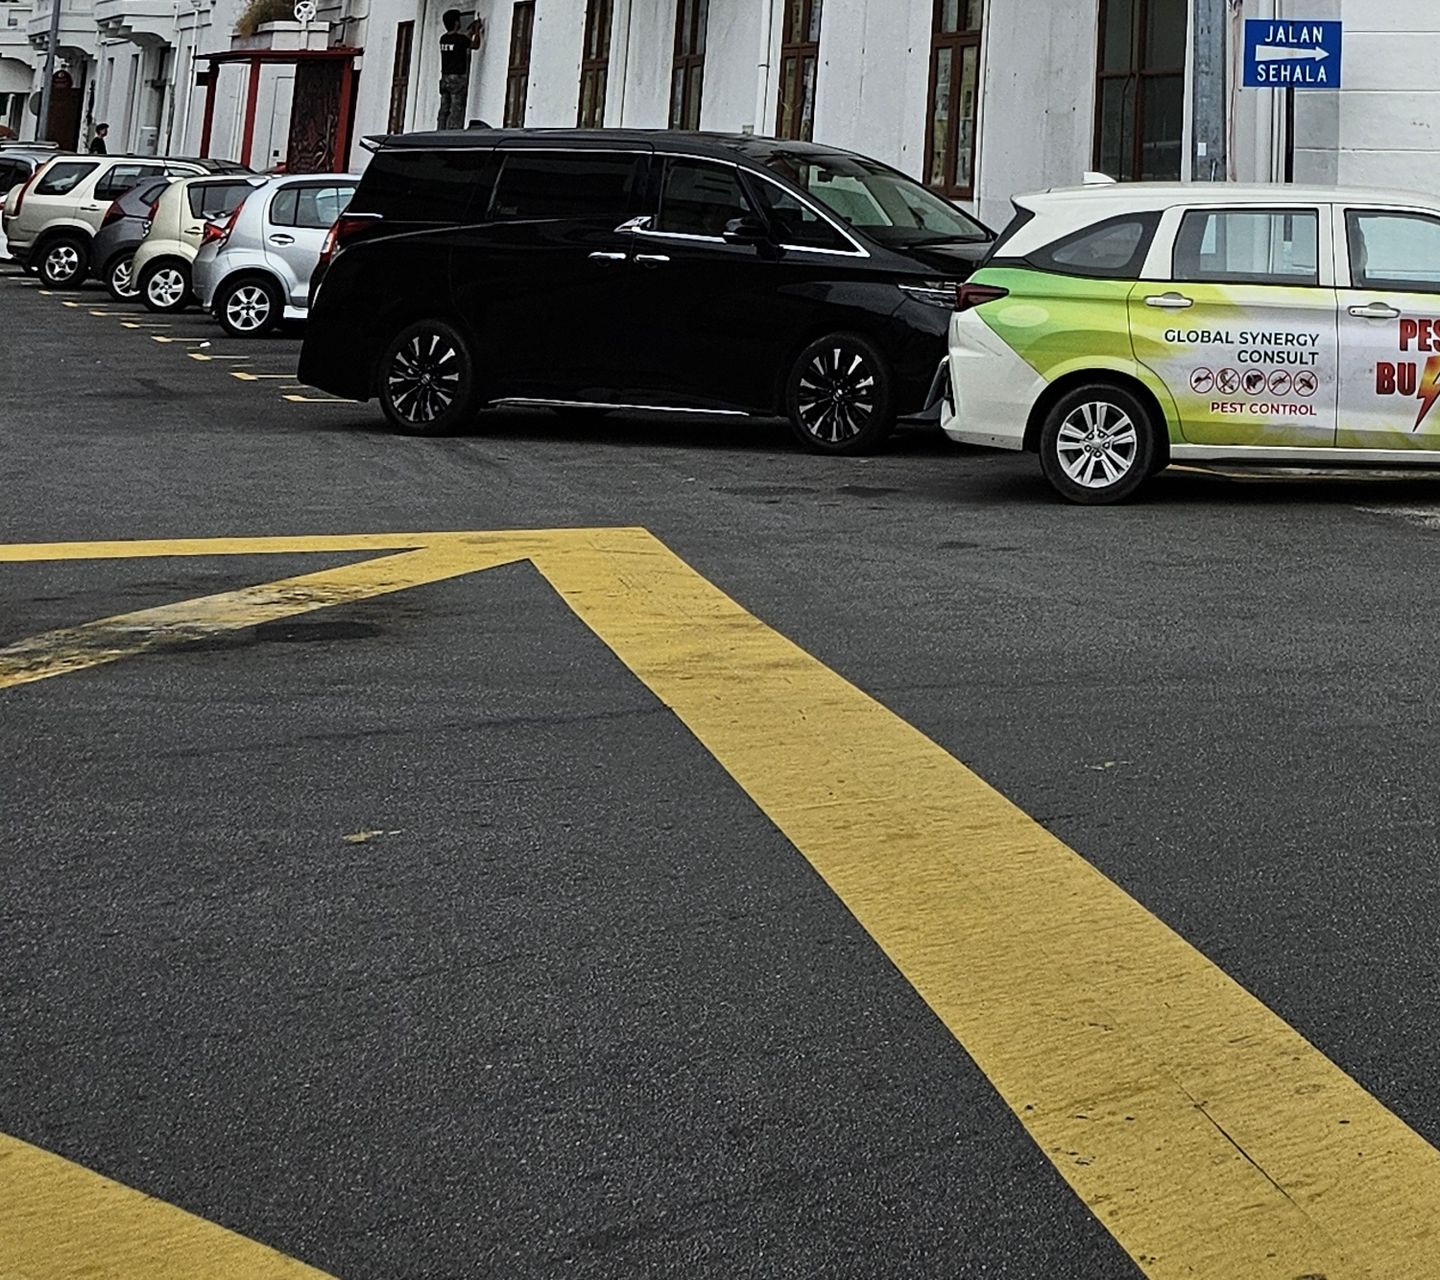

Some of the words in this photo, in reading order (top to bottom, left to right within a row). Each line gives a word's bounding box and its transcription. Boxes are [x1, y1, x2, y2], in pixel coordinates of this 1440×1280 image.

[1265, 25, 1323, 43] JALAN
[1257, 64, 1327, 82] SEHALA
[1164, 329, 1234, 344] GLOBAL
[1239, 331, 1320, 347] SYNERGY
[1237, 350, 1320, 365] CONSULT
[1211, 401, 1246, 413] PEST
[1249, 403, 1317, 416] CONTROL
